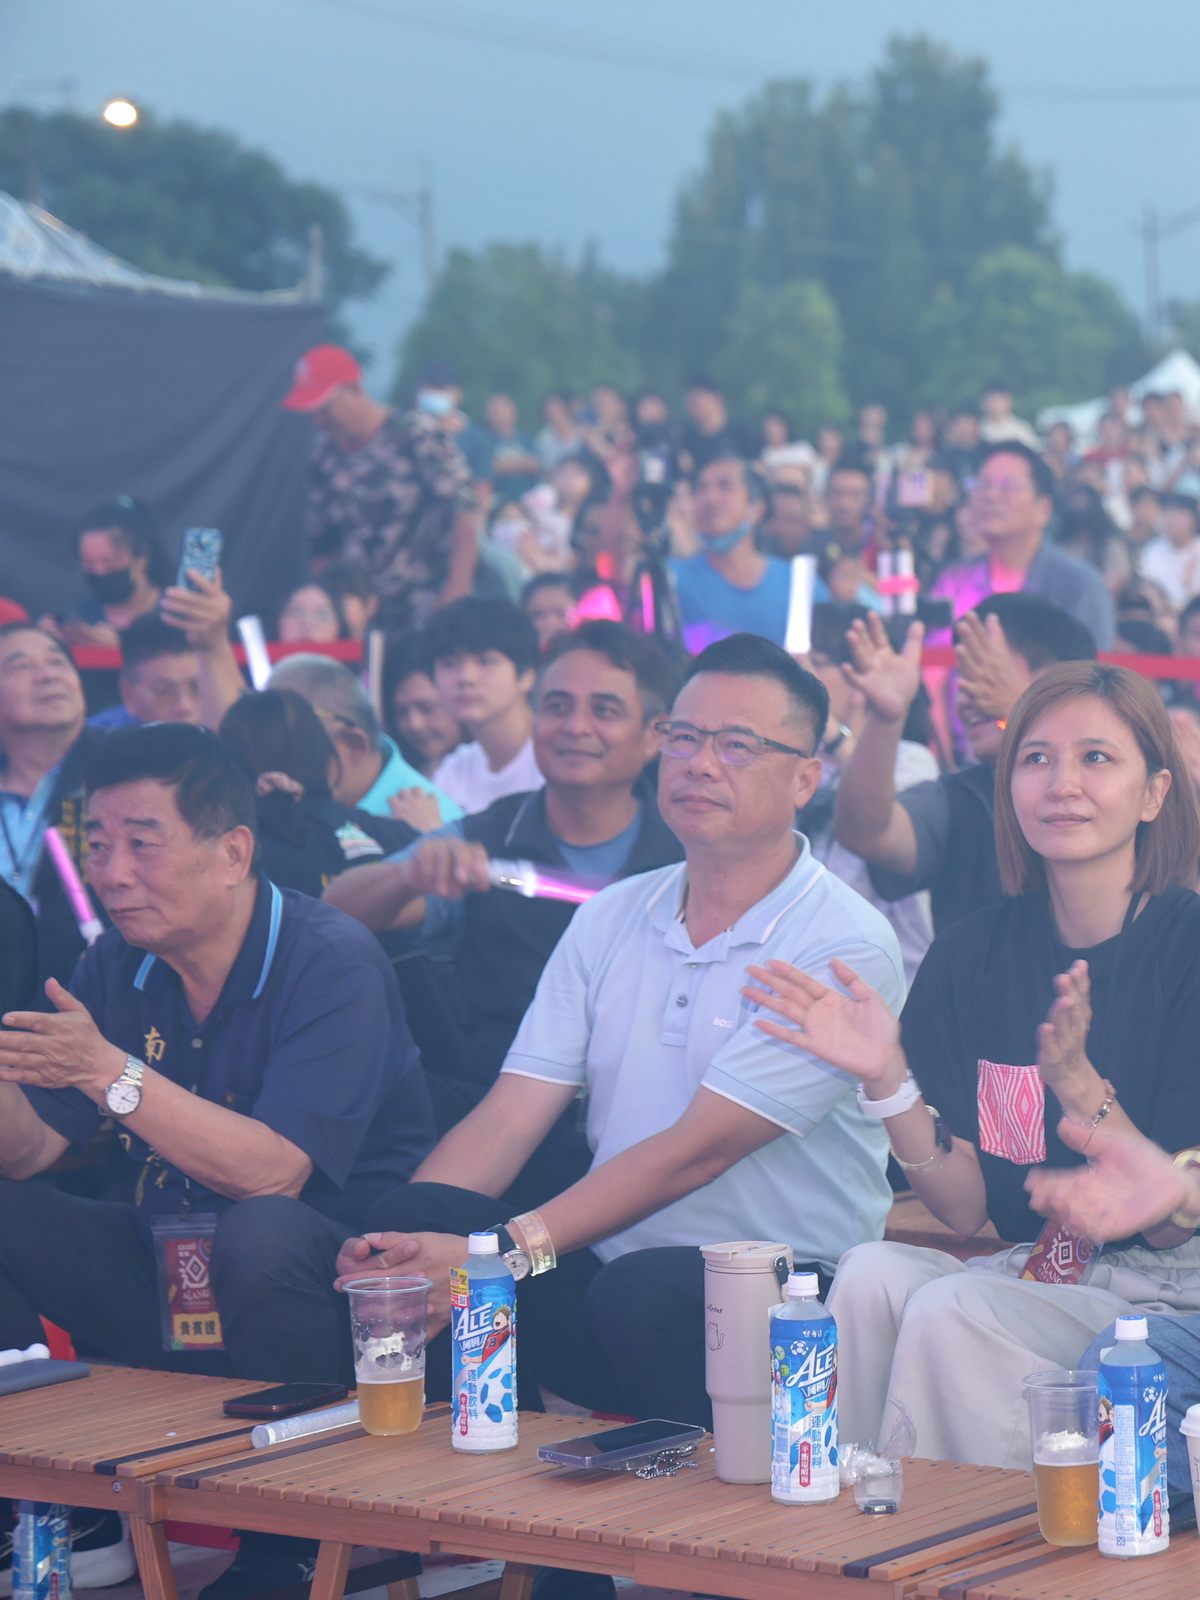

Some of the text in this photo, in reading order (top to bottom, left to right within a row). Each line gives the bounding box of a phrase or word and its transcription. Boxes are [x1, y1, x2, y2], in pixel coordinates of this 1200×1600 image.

[144, 1025, 166, 1063] 南
[180, 1320, 216, 1336] 貴賓證
[454, 1302, 493, 1342] ALE
[786, 1343, 835, 1387] ALE
[1139, 1390, 1167, 1436] AL
[811, 1415, 822, 1468] 運動飲料
